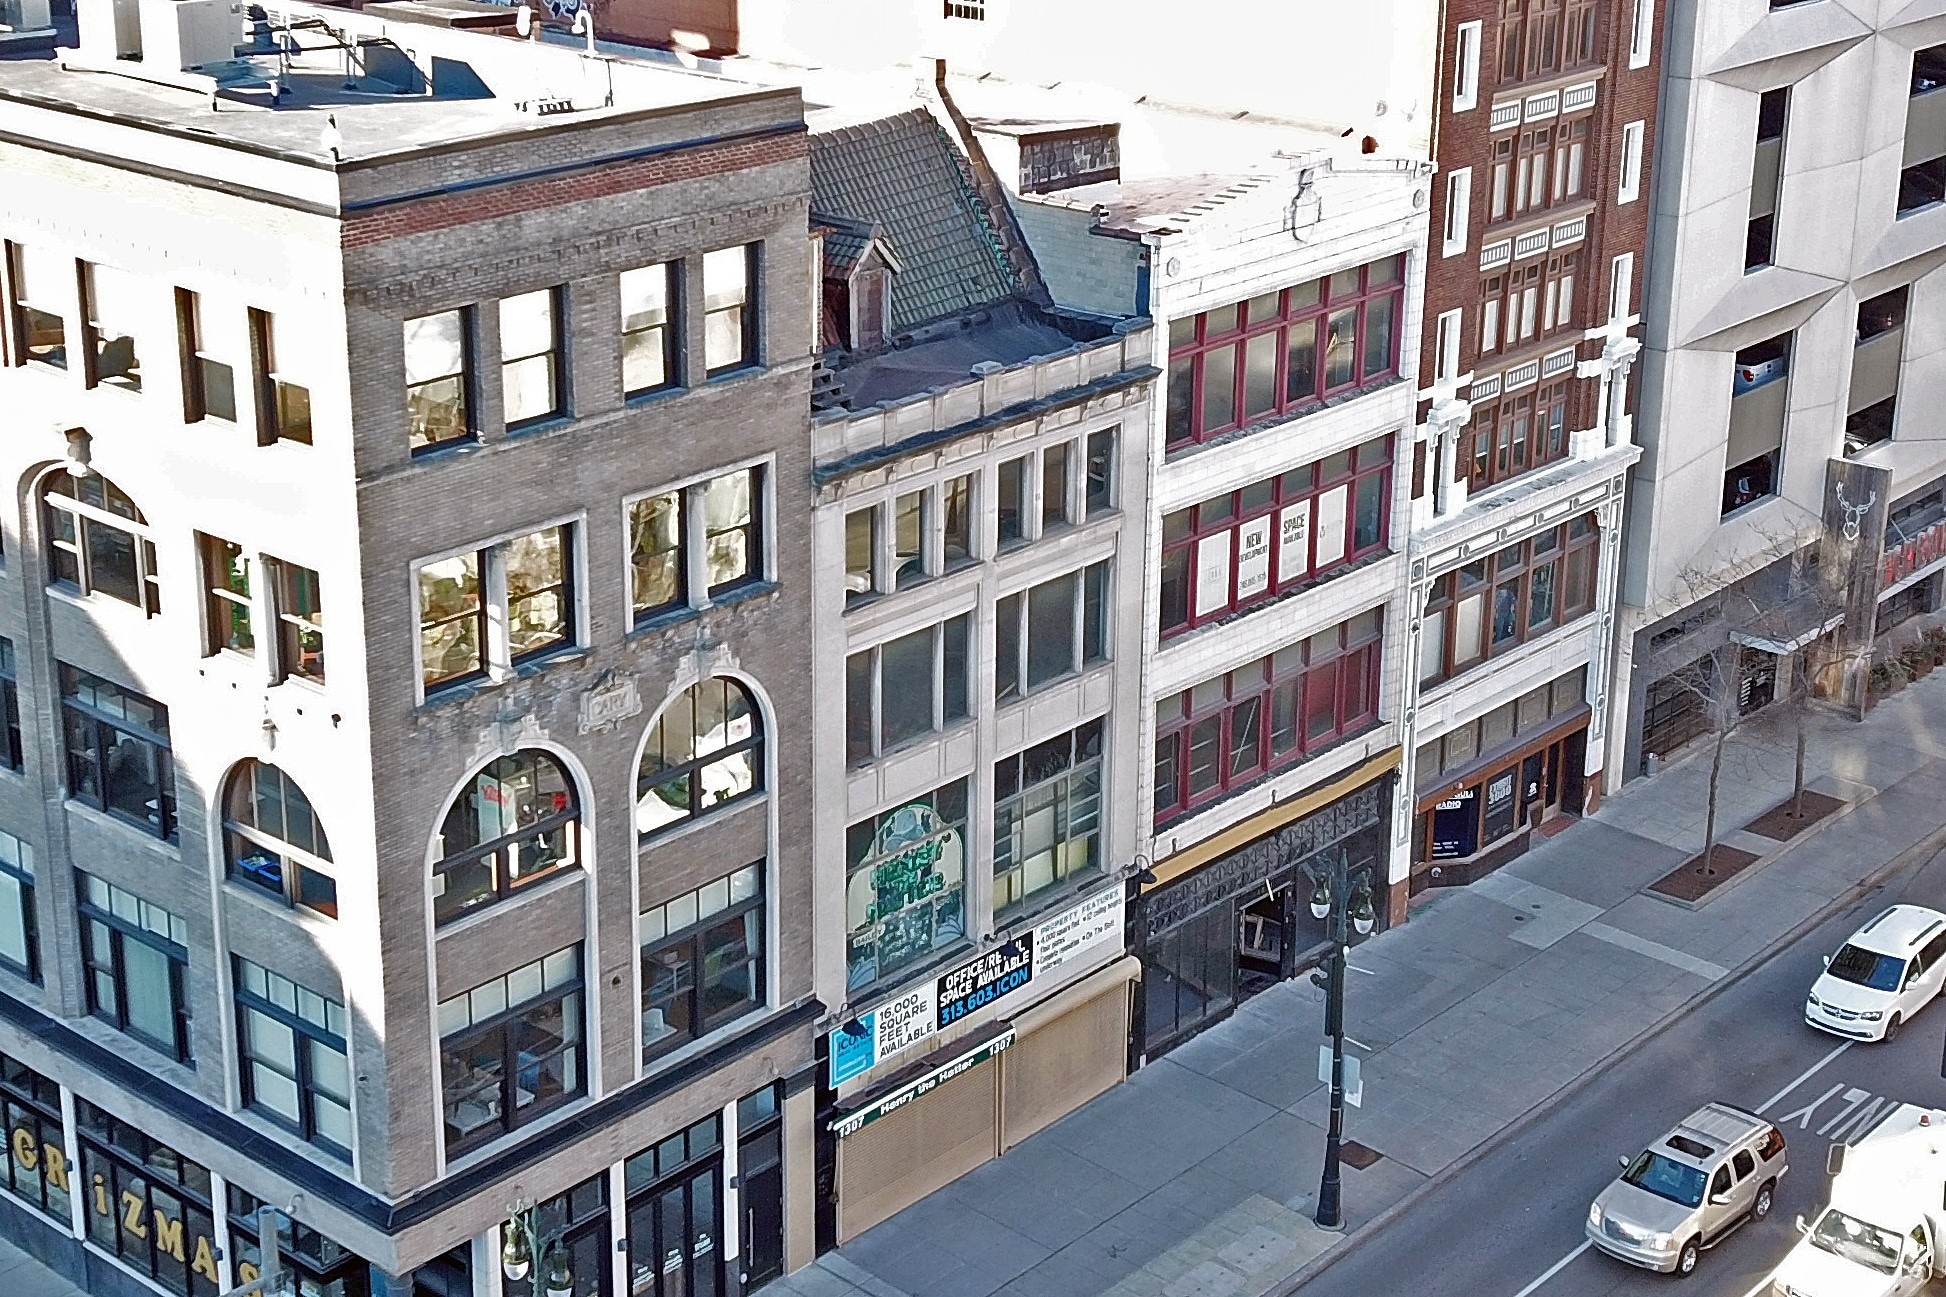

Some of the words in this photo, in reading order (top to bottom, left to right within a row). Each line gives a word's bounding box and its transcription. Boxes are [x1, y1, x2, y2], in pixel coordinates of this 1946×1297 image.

[1246, 531, 1263, 549] NEW
[1283, 513, 1306, 534] SPACE
[940, 979, 973, 1008] SPACE
[977, 949, 1030, 989] AVAILABLE
[945, 939, 1026, 990] OFFICE/REIL
[941, 966, 1028, 1025] 313.603.ICON
[879, 1021, 911, 1047] FEET
[880, 1000, 928, 1034] SQUARE
[837, 1024, 874, 1053] ICOC
[880, 1020, 934, 1059] AVAILABLE
[988, 1034, 1013, 1057] 1307
[880, 1090, 915, 1116] Henry
[917, 1079, 937, 1095] the
[939, 1057, 975, 1083] Hatter
[839, 1115, 865, 1139] 1307
[1778, 1082, 1900, 1145] NLY
